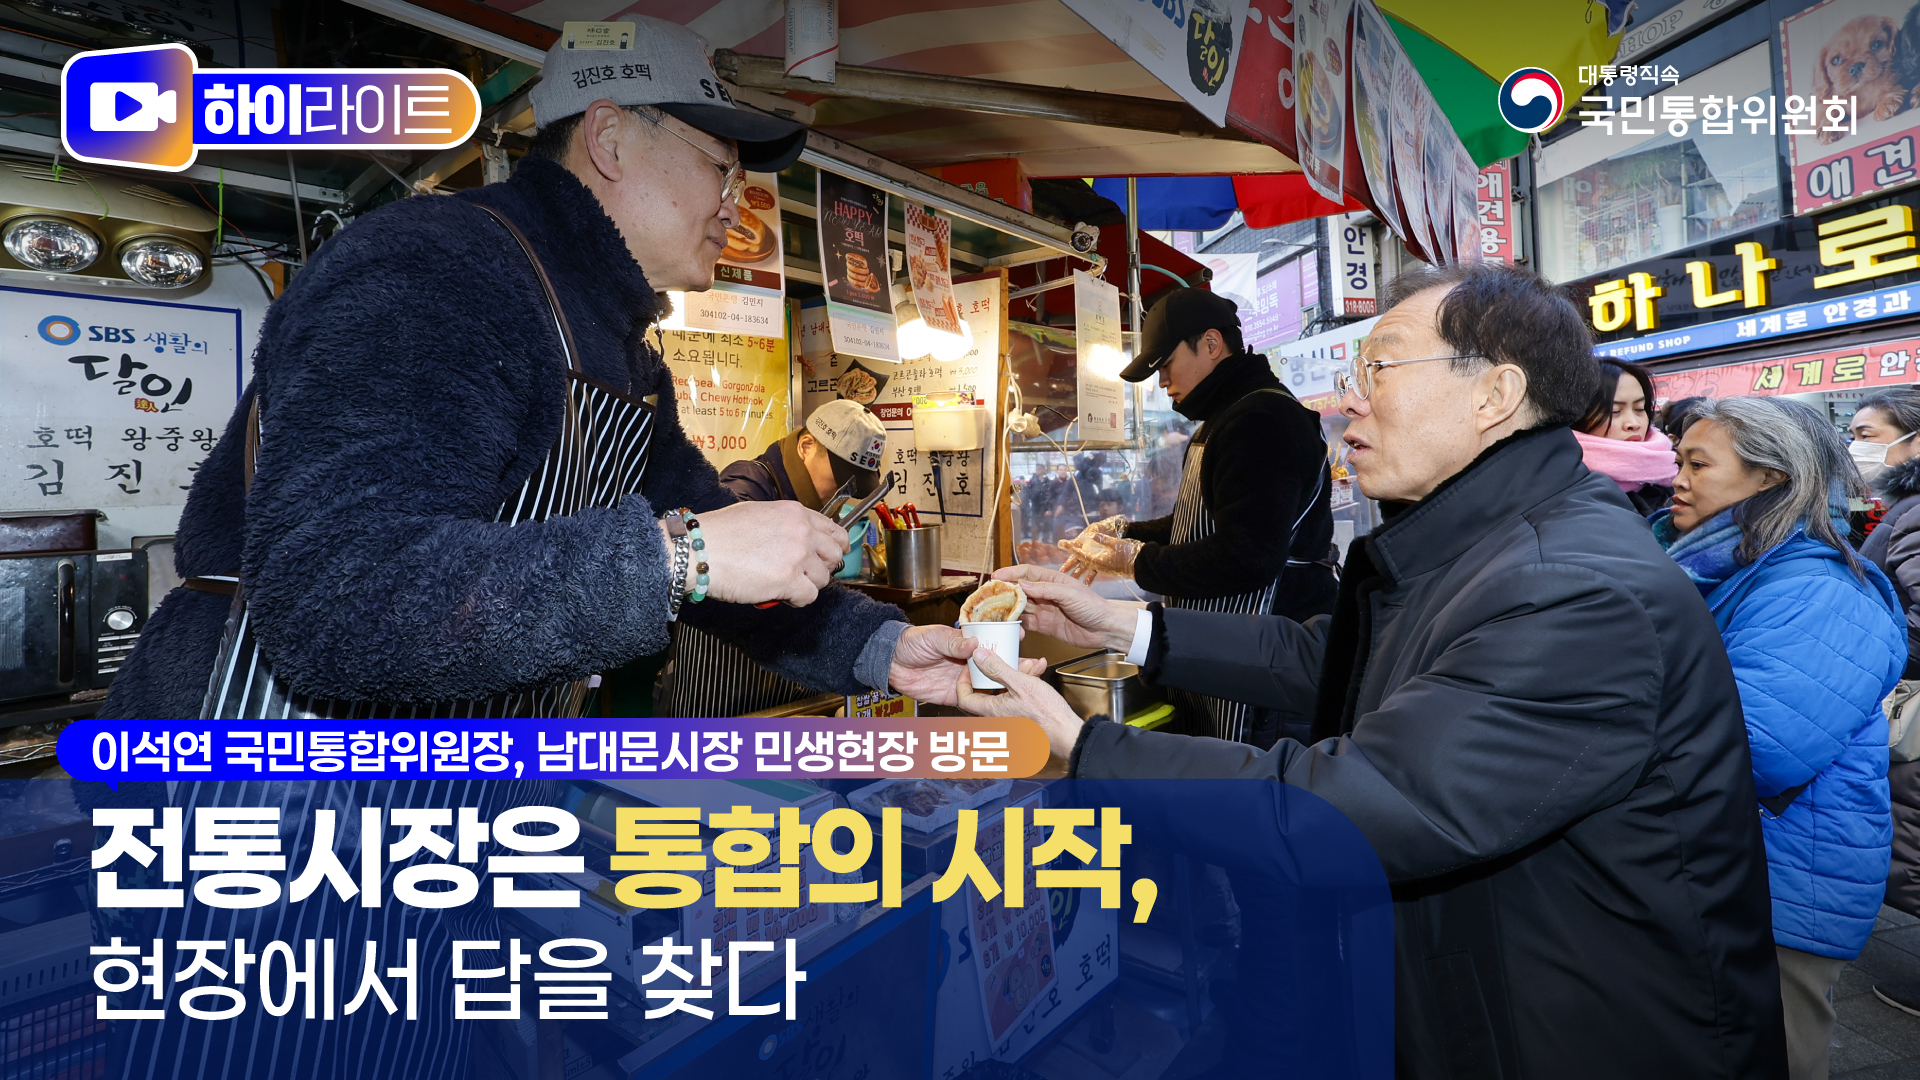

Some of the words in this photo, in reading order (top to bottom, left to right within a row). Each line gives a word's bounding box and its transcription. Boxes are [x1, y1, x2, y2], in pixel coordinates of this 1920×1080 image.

[1192, 13, 1224, 87] 달인
[572, 66, 617, 89] 김진호
[620, 63, 652, 81] 호떡
[1807, 136, 1917, 200] 애견
[834, 200, 873, 225] HAPPY
[845, 227, 865, 247] 호떡
[1344, 228, 1368, 290] 안경
[1588, 204, 1920, 333] 하나로
[720, 266, 753, 281] 신제품
[706, 292, 738, 304] 국민은행
[742, 296, 764, 308] 김민지
[970, 297, 990, 314] 호떡
[1345, 300, 1375, 313] 318-8005
[700, 310, 768, 325] 304102-04-183634
[1736, 309, 1808, 338] 세계로
[1823, 292, 1912, 324] 안경과
[88, 326, 136, 344] SBS
[144, 330, 208, 356] 생활의
[720, 332, 744, 346] 최소
[748, 337, 775, 353] 5~6분
[1610, 342, 1654, 356] REFUND
[1658, 336, 1691, 350] SHOP
[672, 349, 743, 368] 소요됩니다.
[893, 368, 926, 381] 고르곤졸라
[929, 366, 942, 378] 호떡
[1753, 354, 1868, 392] 세계로
[1880, 349, 1920, 378] 안
[68, 353, 193, 413] 달인
[694, 377, 718, 388] bea
[722, 378, 765, 393] GorgonZola
[892, 386, 906, 398] 부산
[700, 392, 731, 405] Chewy
[1312, 396, 1339, 410] 757-5
[681, 406, 691, 414] at
[692, 406, 716, 416] least
[719, 408, 724, 416] 5
[726, 408, 734, 417] to
[735, 409, 740, 417] 6
[880, 408, 903, 418] 창업문의
[27, 426, 94, 452] 호떡
[692, 434, 747, 452] ₩3,000
[894, 448, 917, 465] 호떡
[928, 450, 970, 467] 중왕
[894, 469, 970, 496] 김진호
[856, 694, 870, 708] 찹쌀
[872, 691, 880, 703] 꿀
[1075, 934, 1111, 992] 호떡
[777, 1018, 803, 1048] SBS
